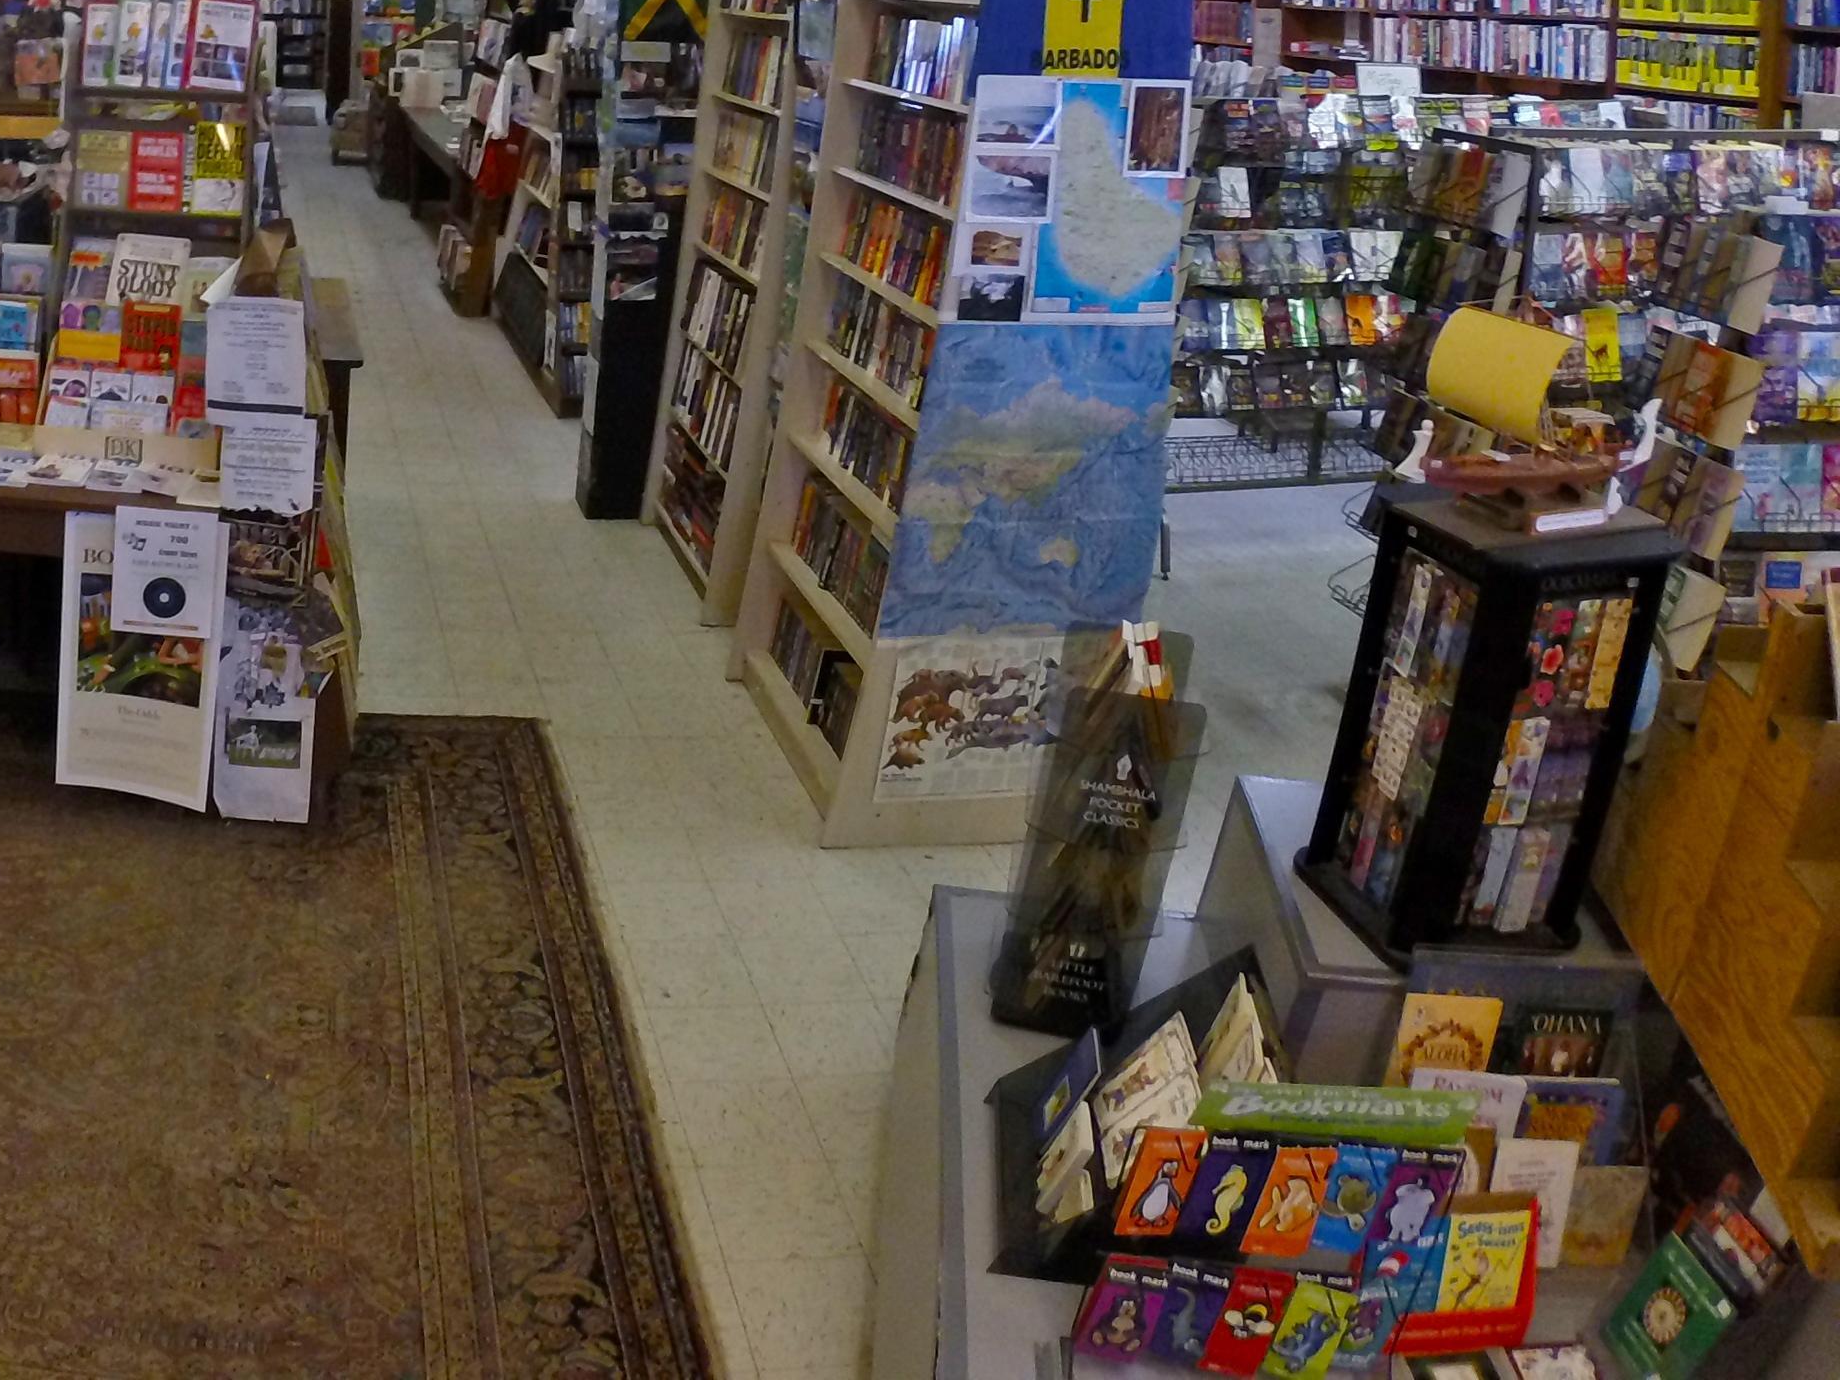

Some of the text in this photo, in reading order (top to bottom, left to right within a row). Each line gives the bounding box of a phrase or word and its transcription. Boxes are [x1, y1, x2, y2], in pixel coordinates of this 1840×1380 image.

[110, 438, 137, 457] DK
[1079, 779, 1157, 802] SHAMBHALA
[1088, 796, 1142, 814] POCKET
[1082, 811, 1140, 829] CLASSICS
[1424, 1043, 1466, 1061] ALOHA
[1220, 1094, 1452, 1120] Bookmarks
